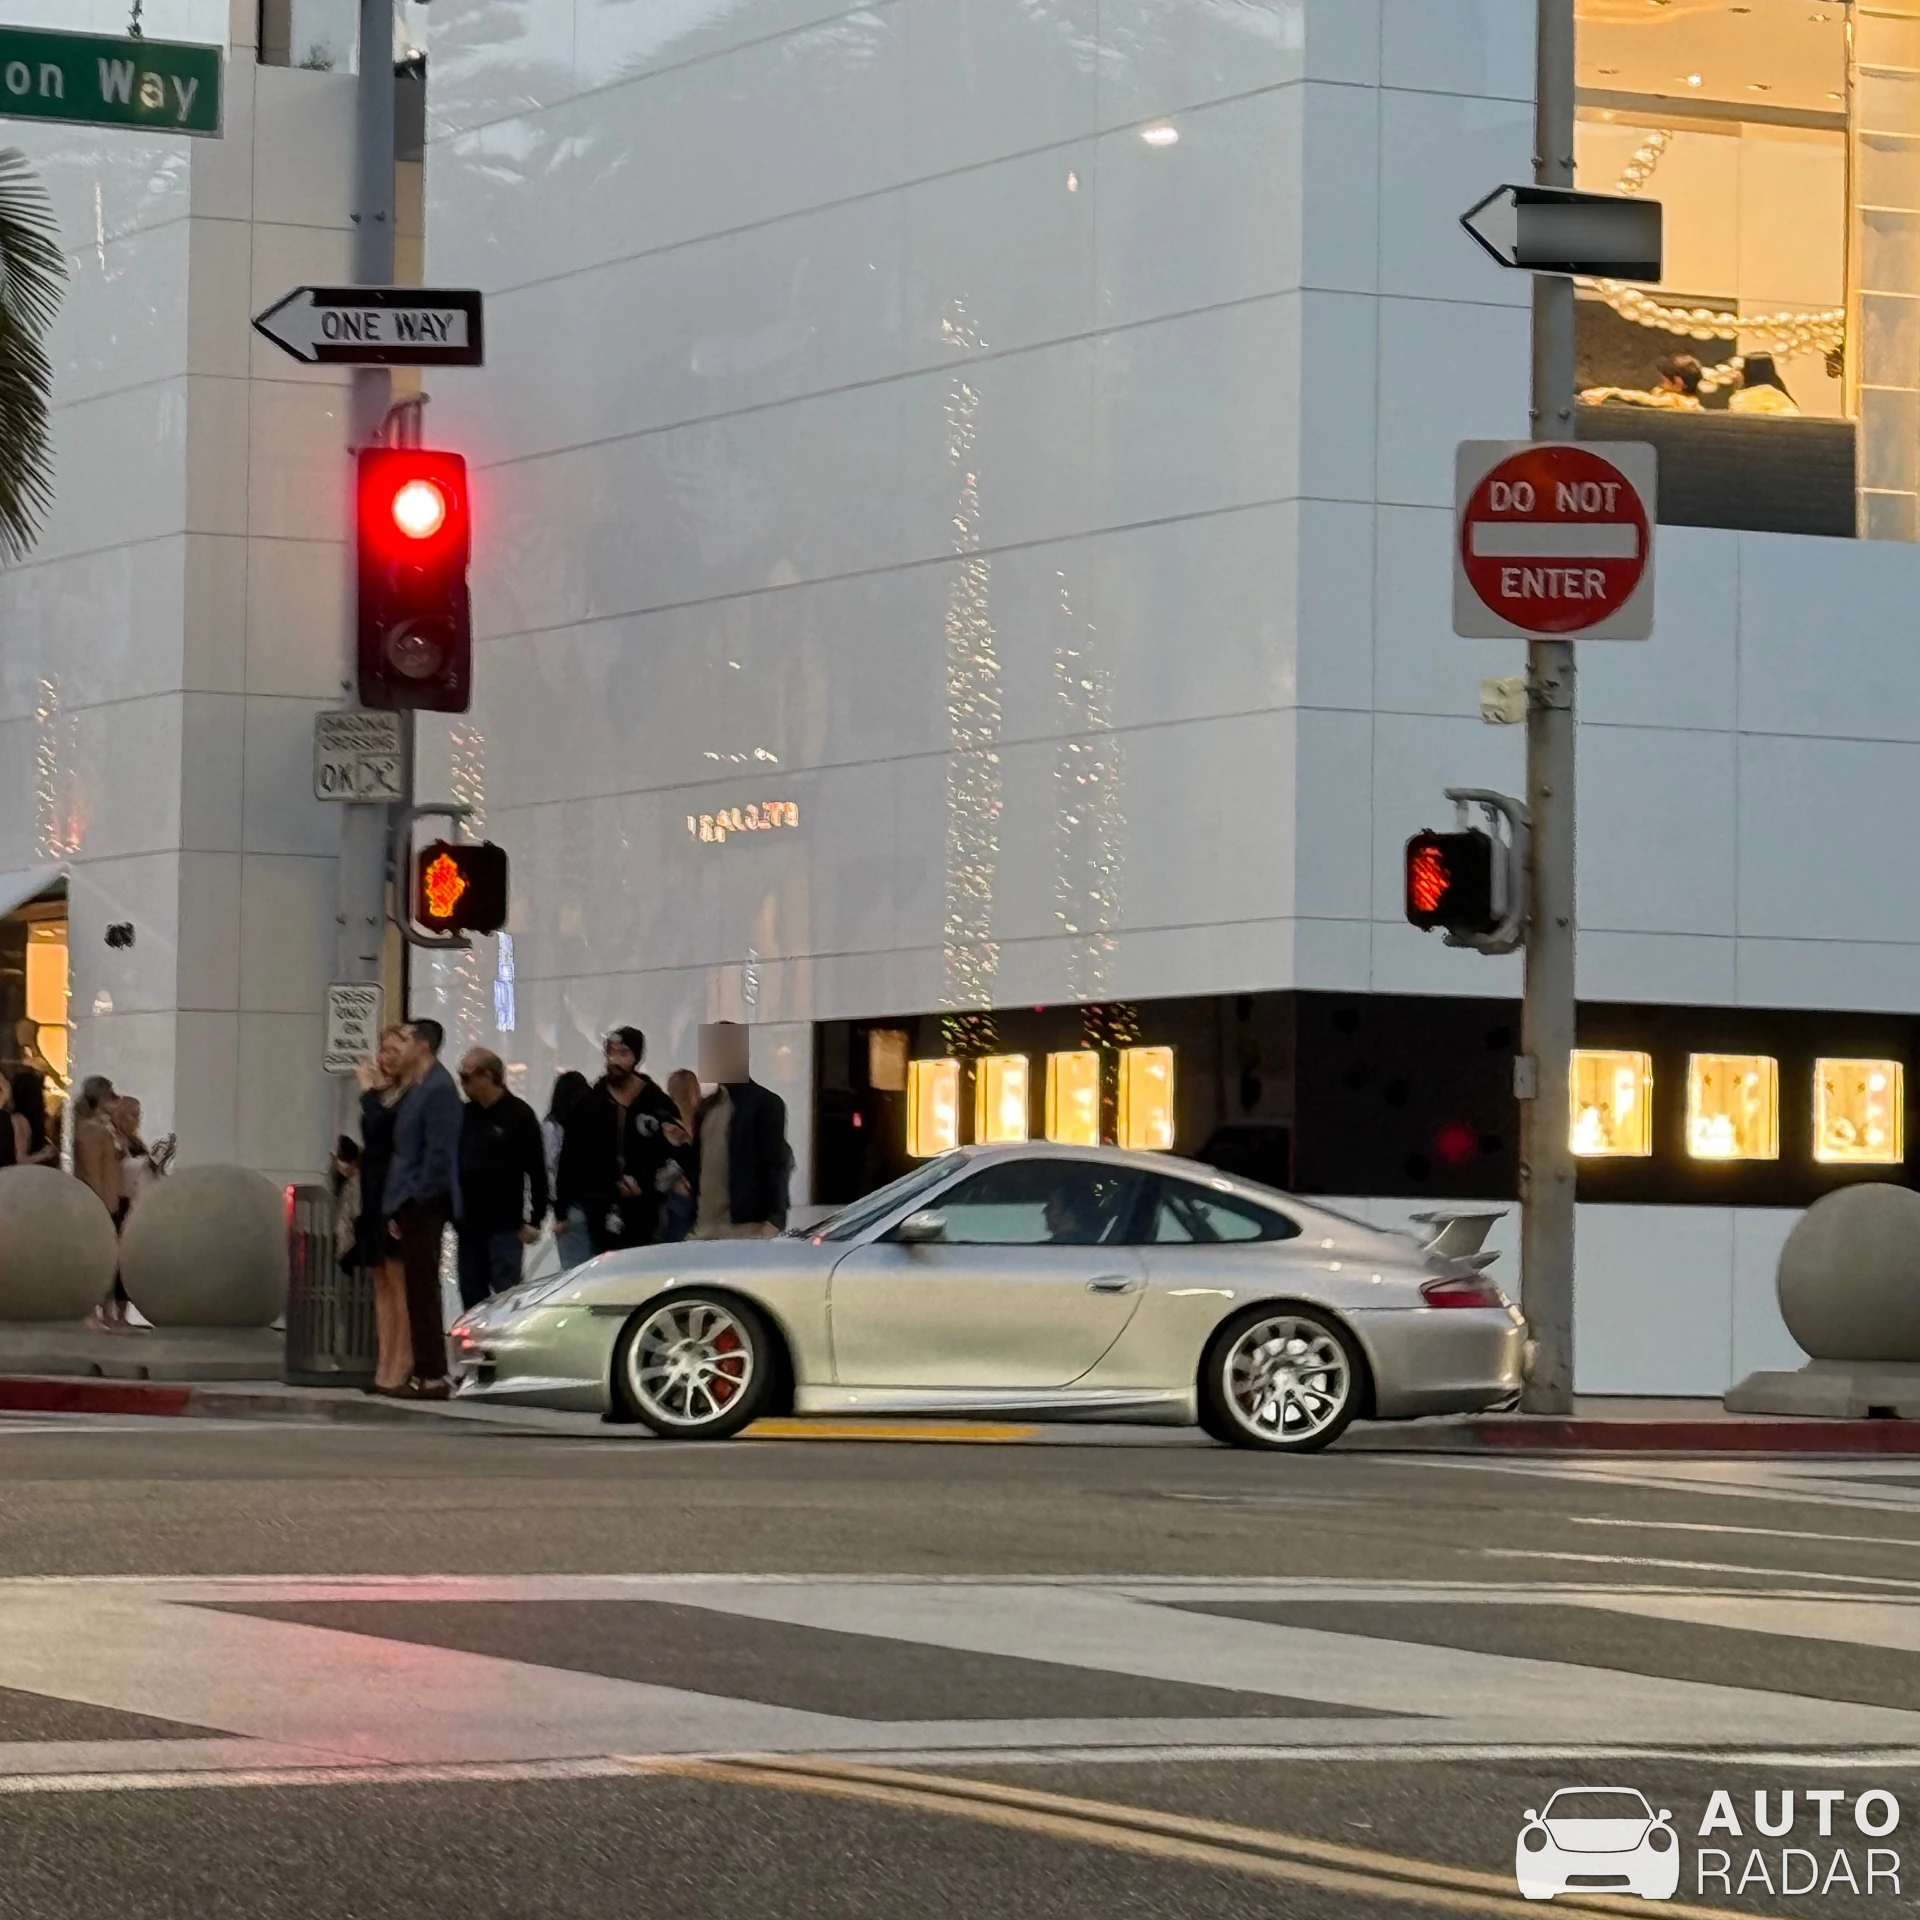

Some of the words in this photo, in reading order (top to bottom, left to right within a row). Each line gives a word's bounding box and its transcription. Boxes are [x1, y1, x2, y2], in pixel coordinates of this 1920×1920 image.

[5, 60, 64, 99] on
[97, 57, 200, 122] Way
[321, 311, 382, 341] ONE
[392, 312, 453, 342] WAY
[1490, 480, 1536, 512] DO
[1555, 481, 1622, 513] NOT
[1501, 567, 1607, 600] ENTER
